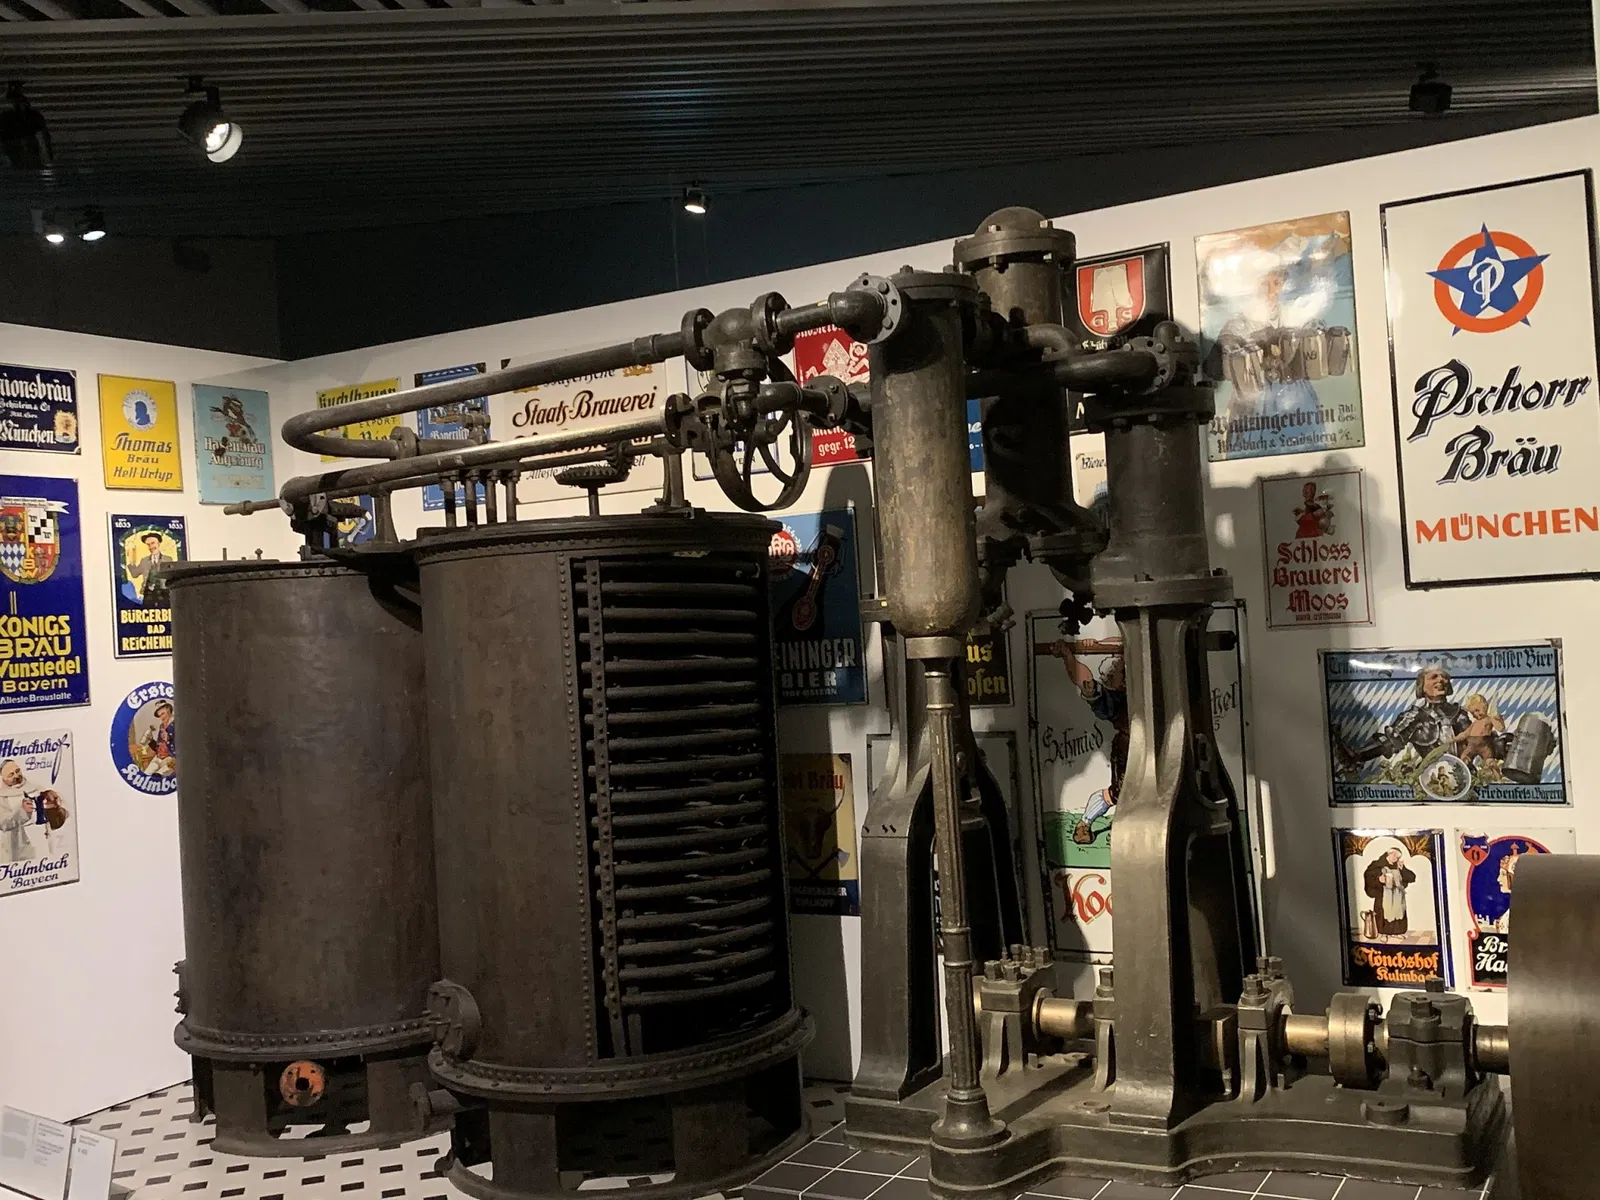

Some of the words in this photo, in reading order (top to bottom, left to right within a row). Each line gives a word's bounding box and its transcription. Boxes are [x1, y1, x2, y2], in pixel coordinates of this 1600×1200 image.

[1406, 358, 1592, 443] Pschorr
[111, 432, 172, 454] Thomas
[1435, 424, 1562, 486] Bräu
[632, 456, 647, 471] elt
[1415, 506, 1600, 544] MÜNCHEN
[1276, 540, 1352, 565] Schloss
[1272, 561, 1360, 588] Brauerei
[1287, 588, 1349, 613] Moos
[146, 624, 166, 635] BAD
[0, 635, 72, 660] BRÄU
[2, 677, 68, 693] Bayern
[127, 682, 175, 710] Erste
[0, 853, 70, 881] Kulmbach
